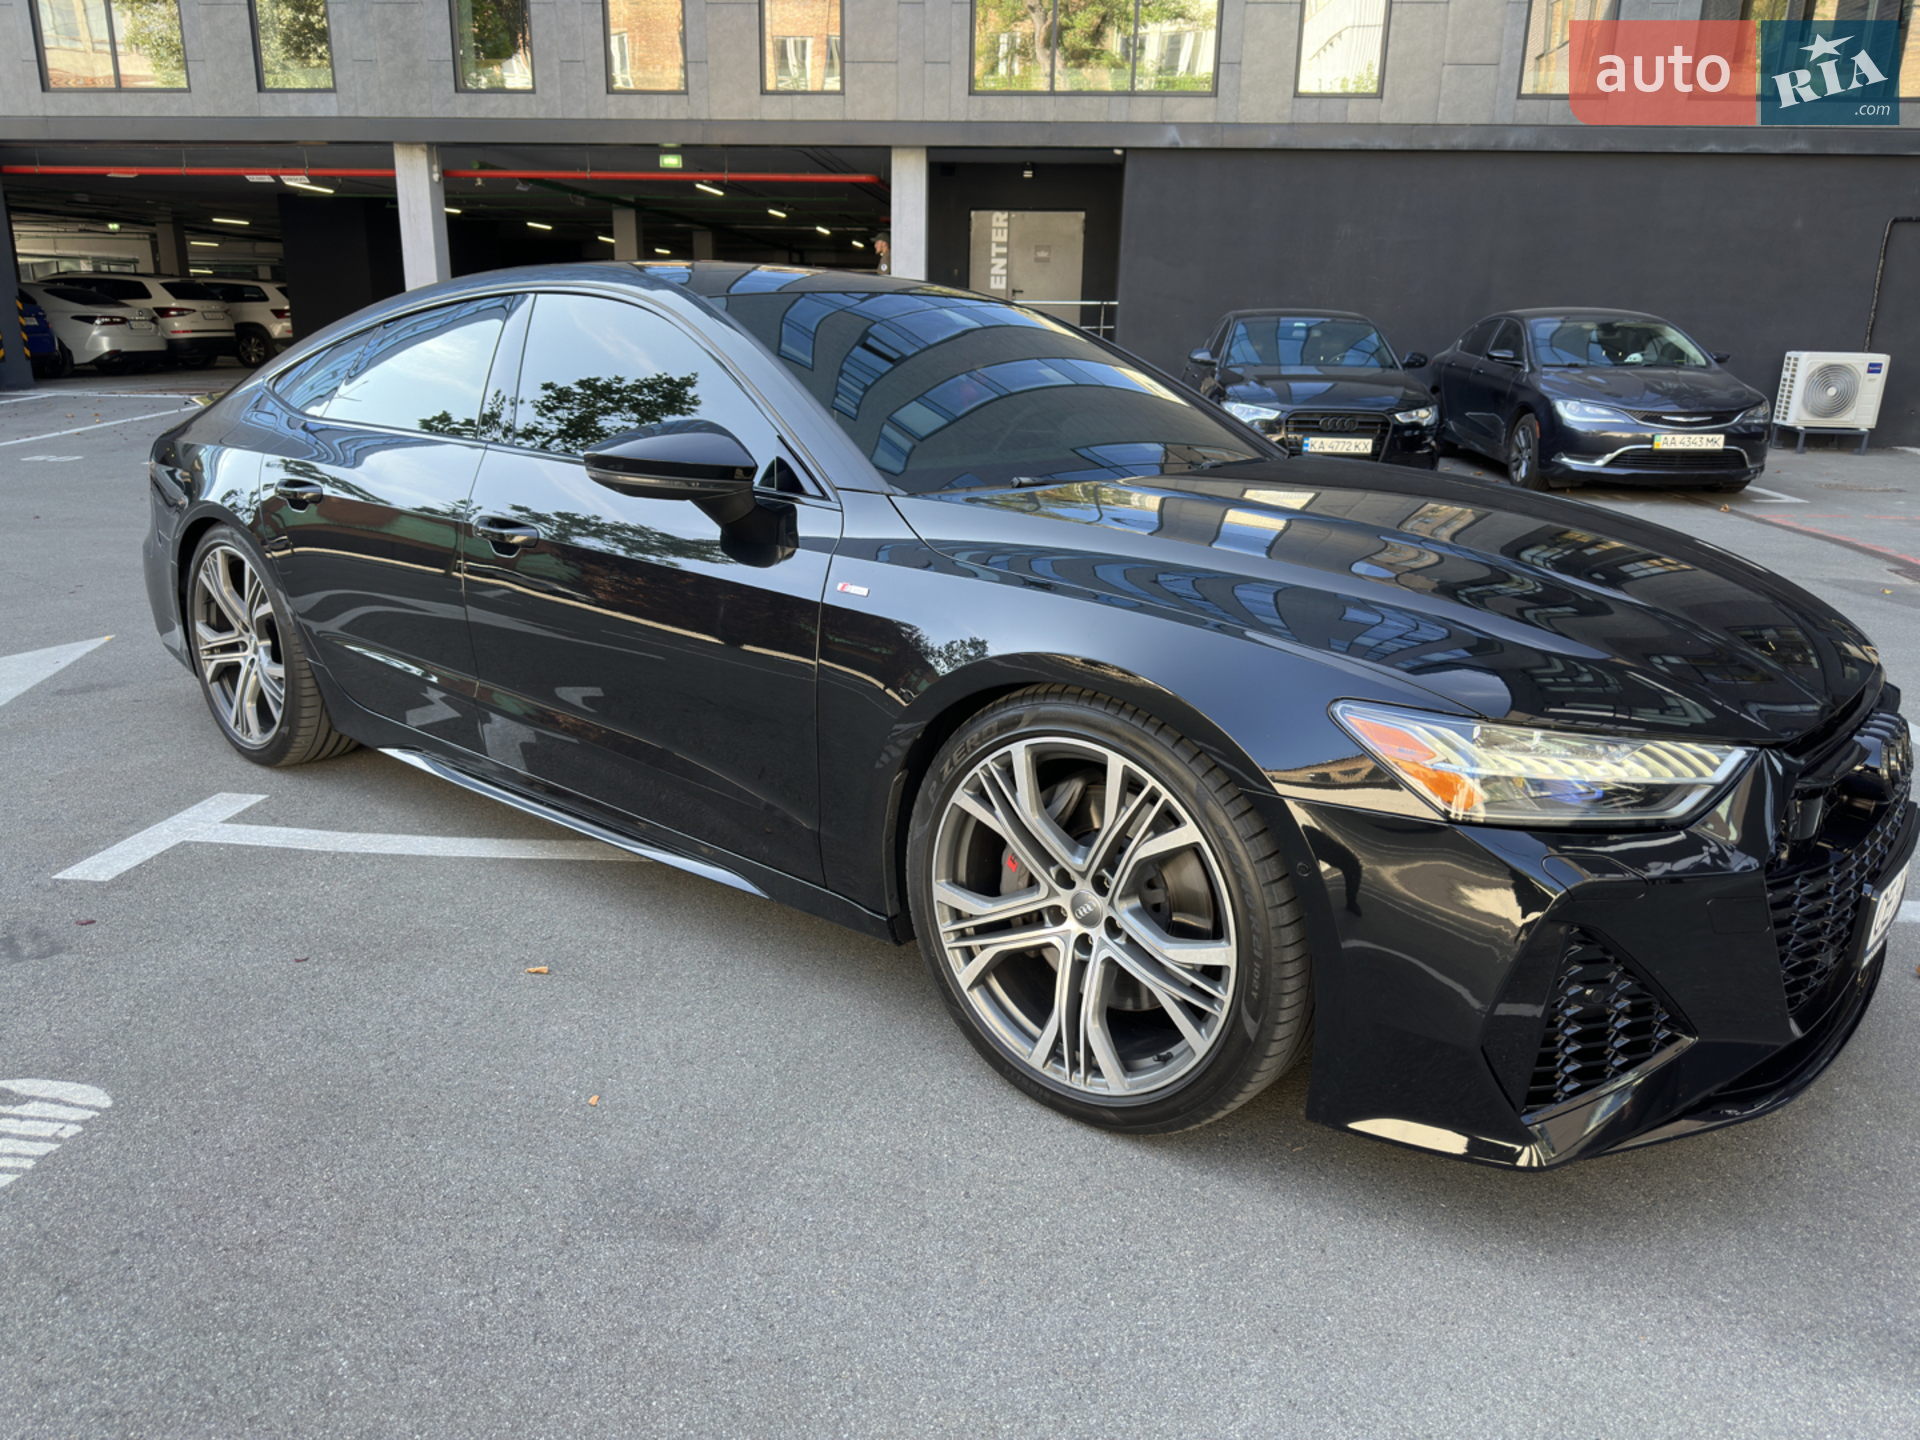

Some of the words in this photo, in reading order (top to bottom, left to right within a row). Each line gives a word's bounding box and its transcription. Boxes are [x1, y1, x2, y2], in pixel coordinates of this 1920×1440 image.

[989, 211, 1009, 290] ENTER
[1310, 440, 1325, 451] KA
[1328, 440, 1352, 451] 4772
[1354, 441, 1371, 452] KX
[1662, 436, 1677, 447] AA
[1679, 436, 1704, 447] 4343
[1706, 436, 1722, 447] MK
[939, 720, 999, 783] ZERO
